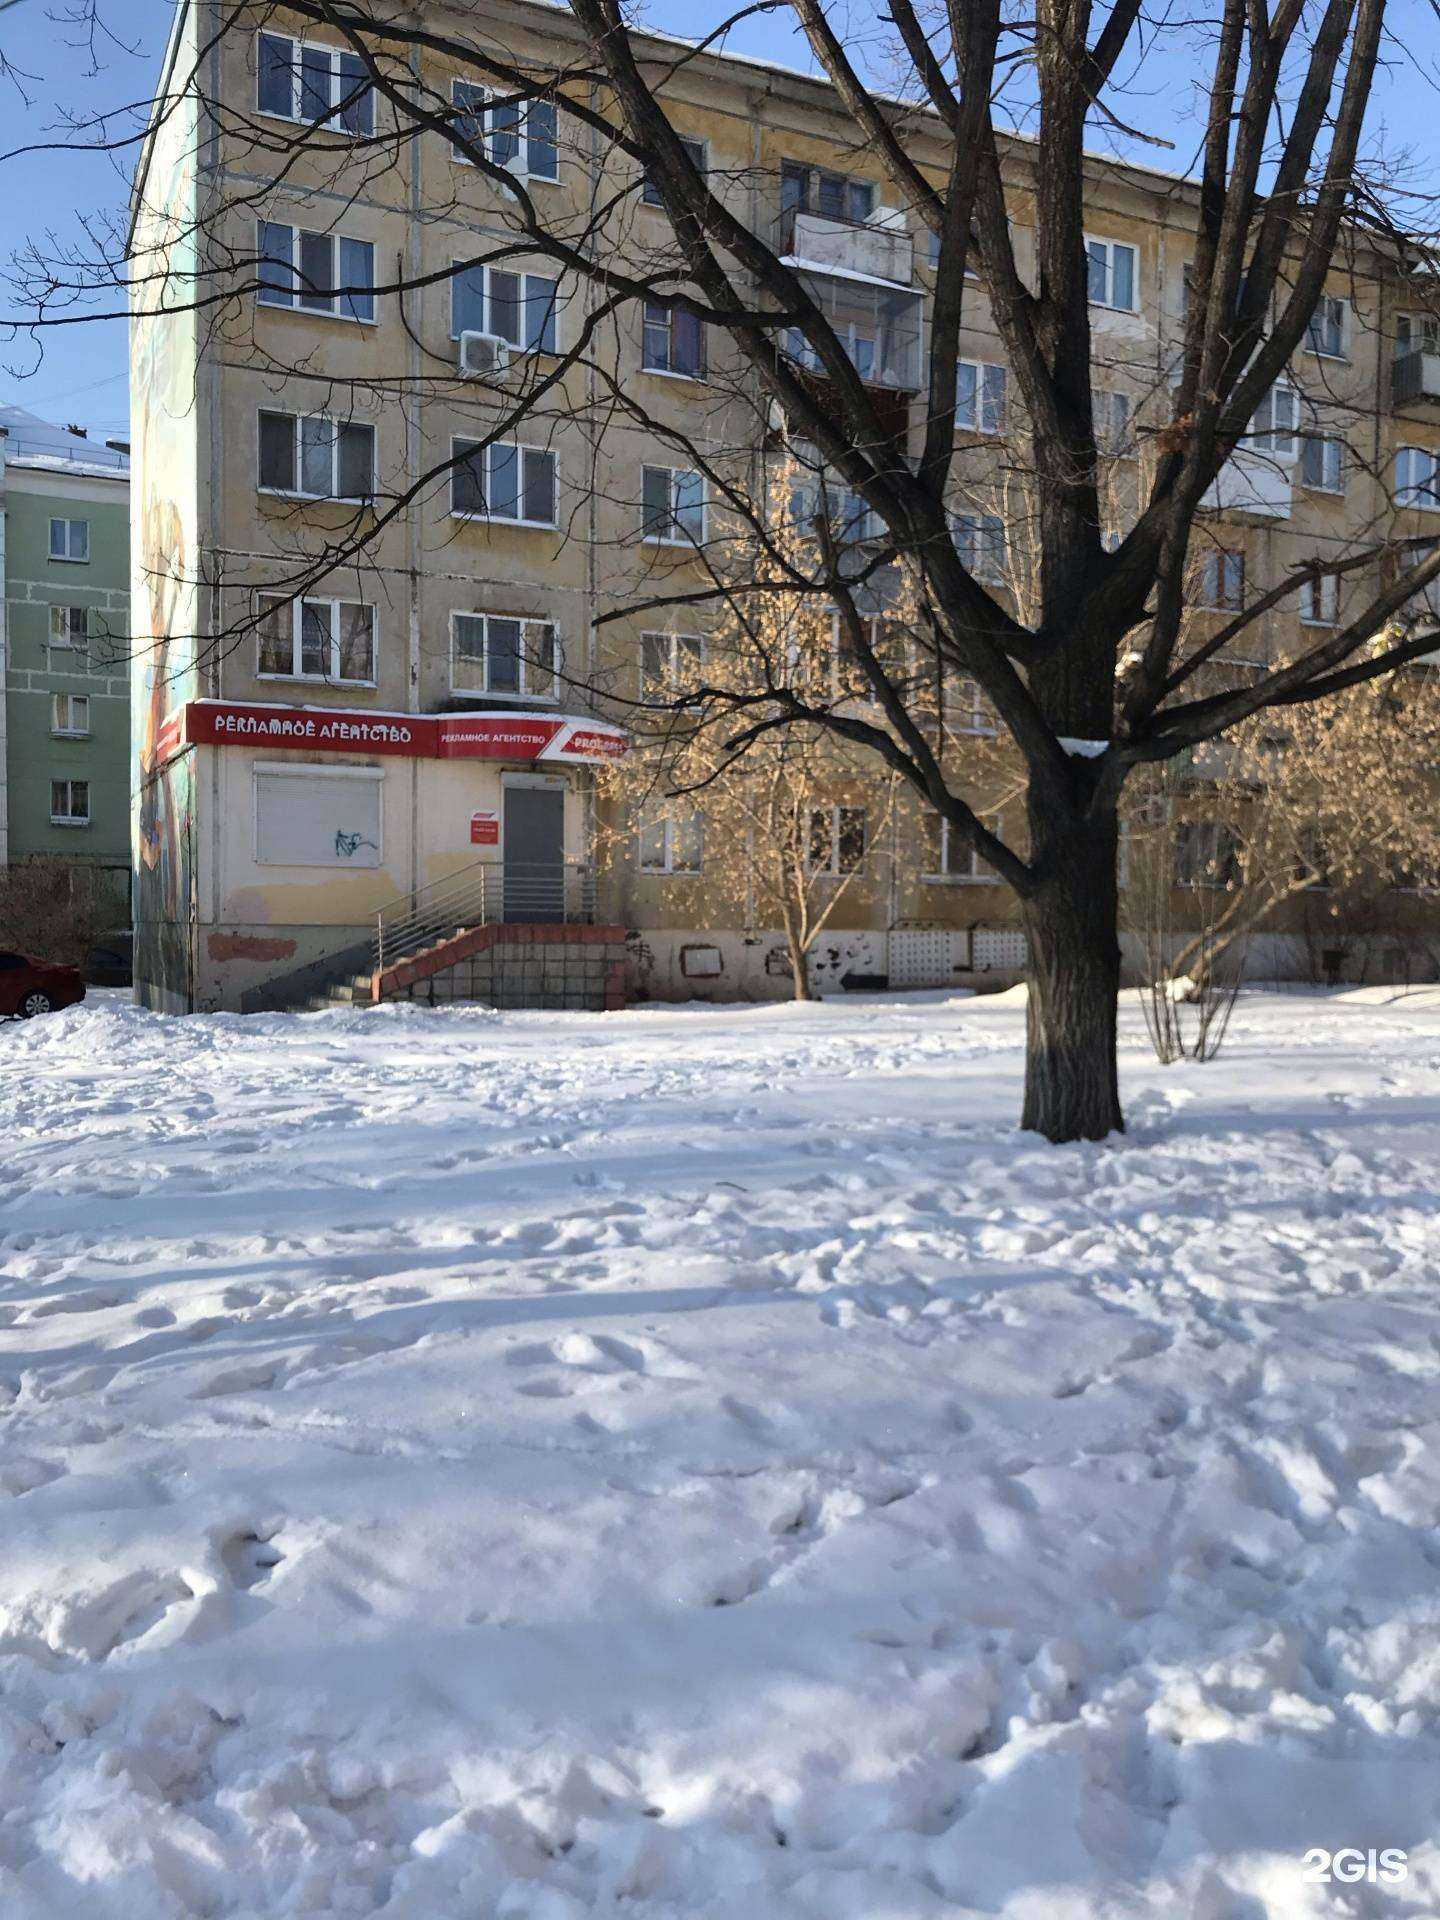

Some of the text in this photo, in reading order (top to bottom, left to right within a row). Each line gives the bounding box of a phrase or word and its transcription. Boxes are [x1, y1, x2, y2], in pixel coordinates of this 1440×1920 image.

[215, 715, 411, 743] РЕКЛАМНОЕ АГЕНТСТВО
[441, 733, 545, 744] РЕКЛАМНОЕ АГЕНТСТВО
